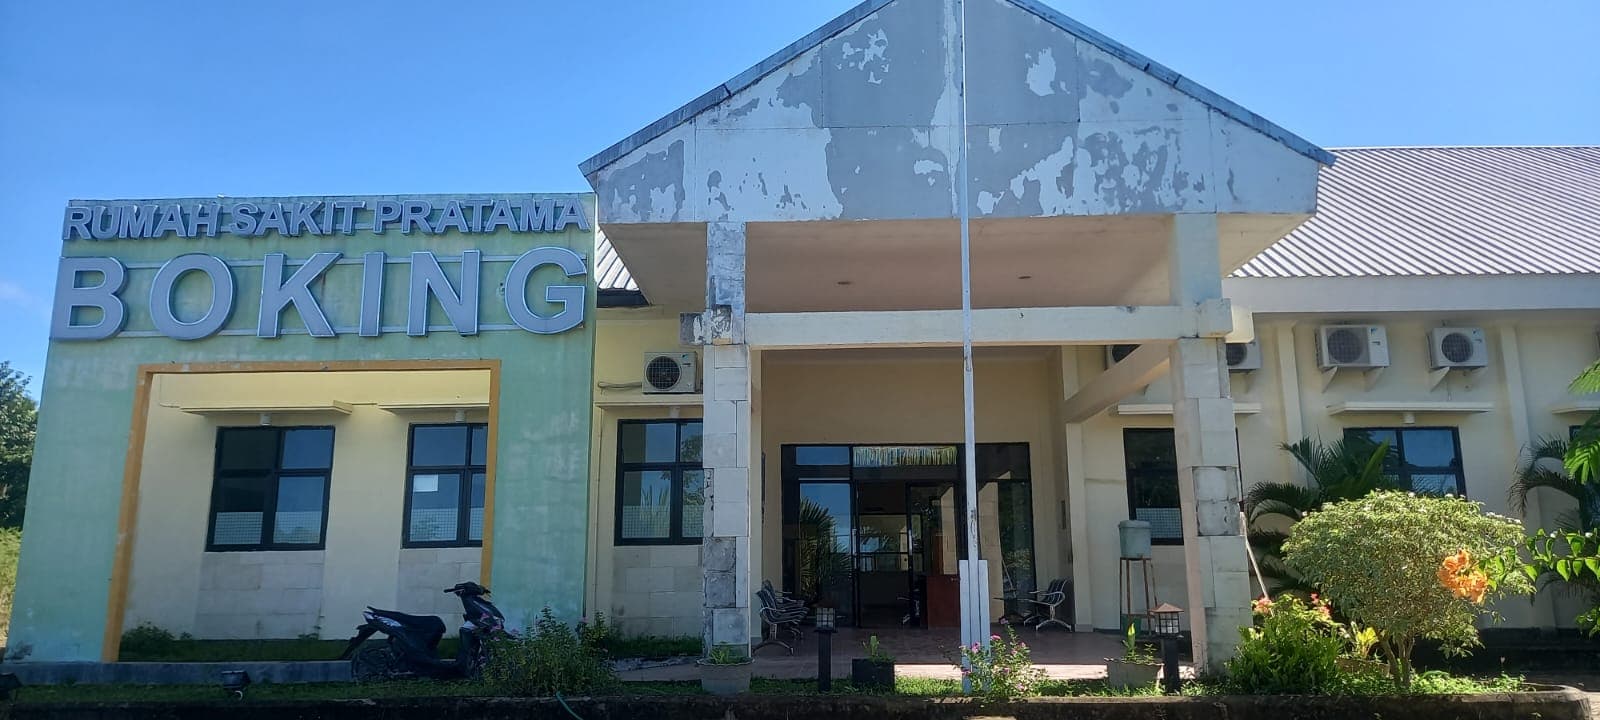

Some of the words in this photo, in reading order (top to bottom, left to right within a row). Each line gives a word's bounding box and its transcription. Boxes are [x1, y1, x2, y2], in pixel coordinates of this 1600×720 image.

[63, 203, 221, 240] RUMAH
[231, 200, 366, 237] SAKIT
[373, 199, 591, 234] PRATAMA
[51, 246, 587, 341] BOKING
